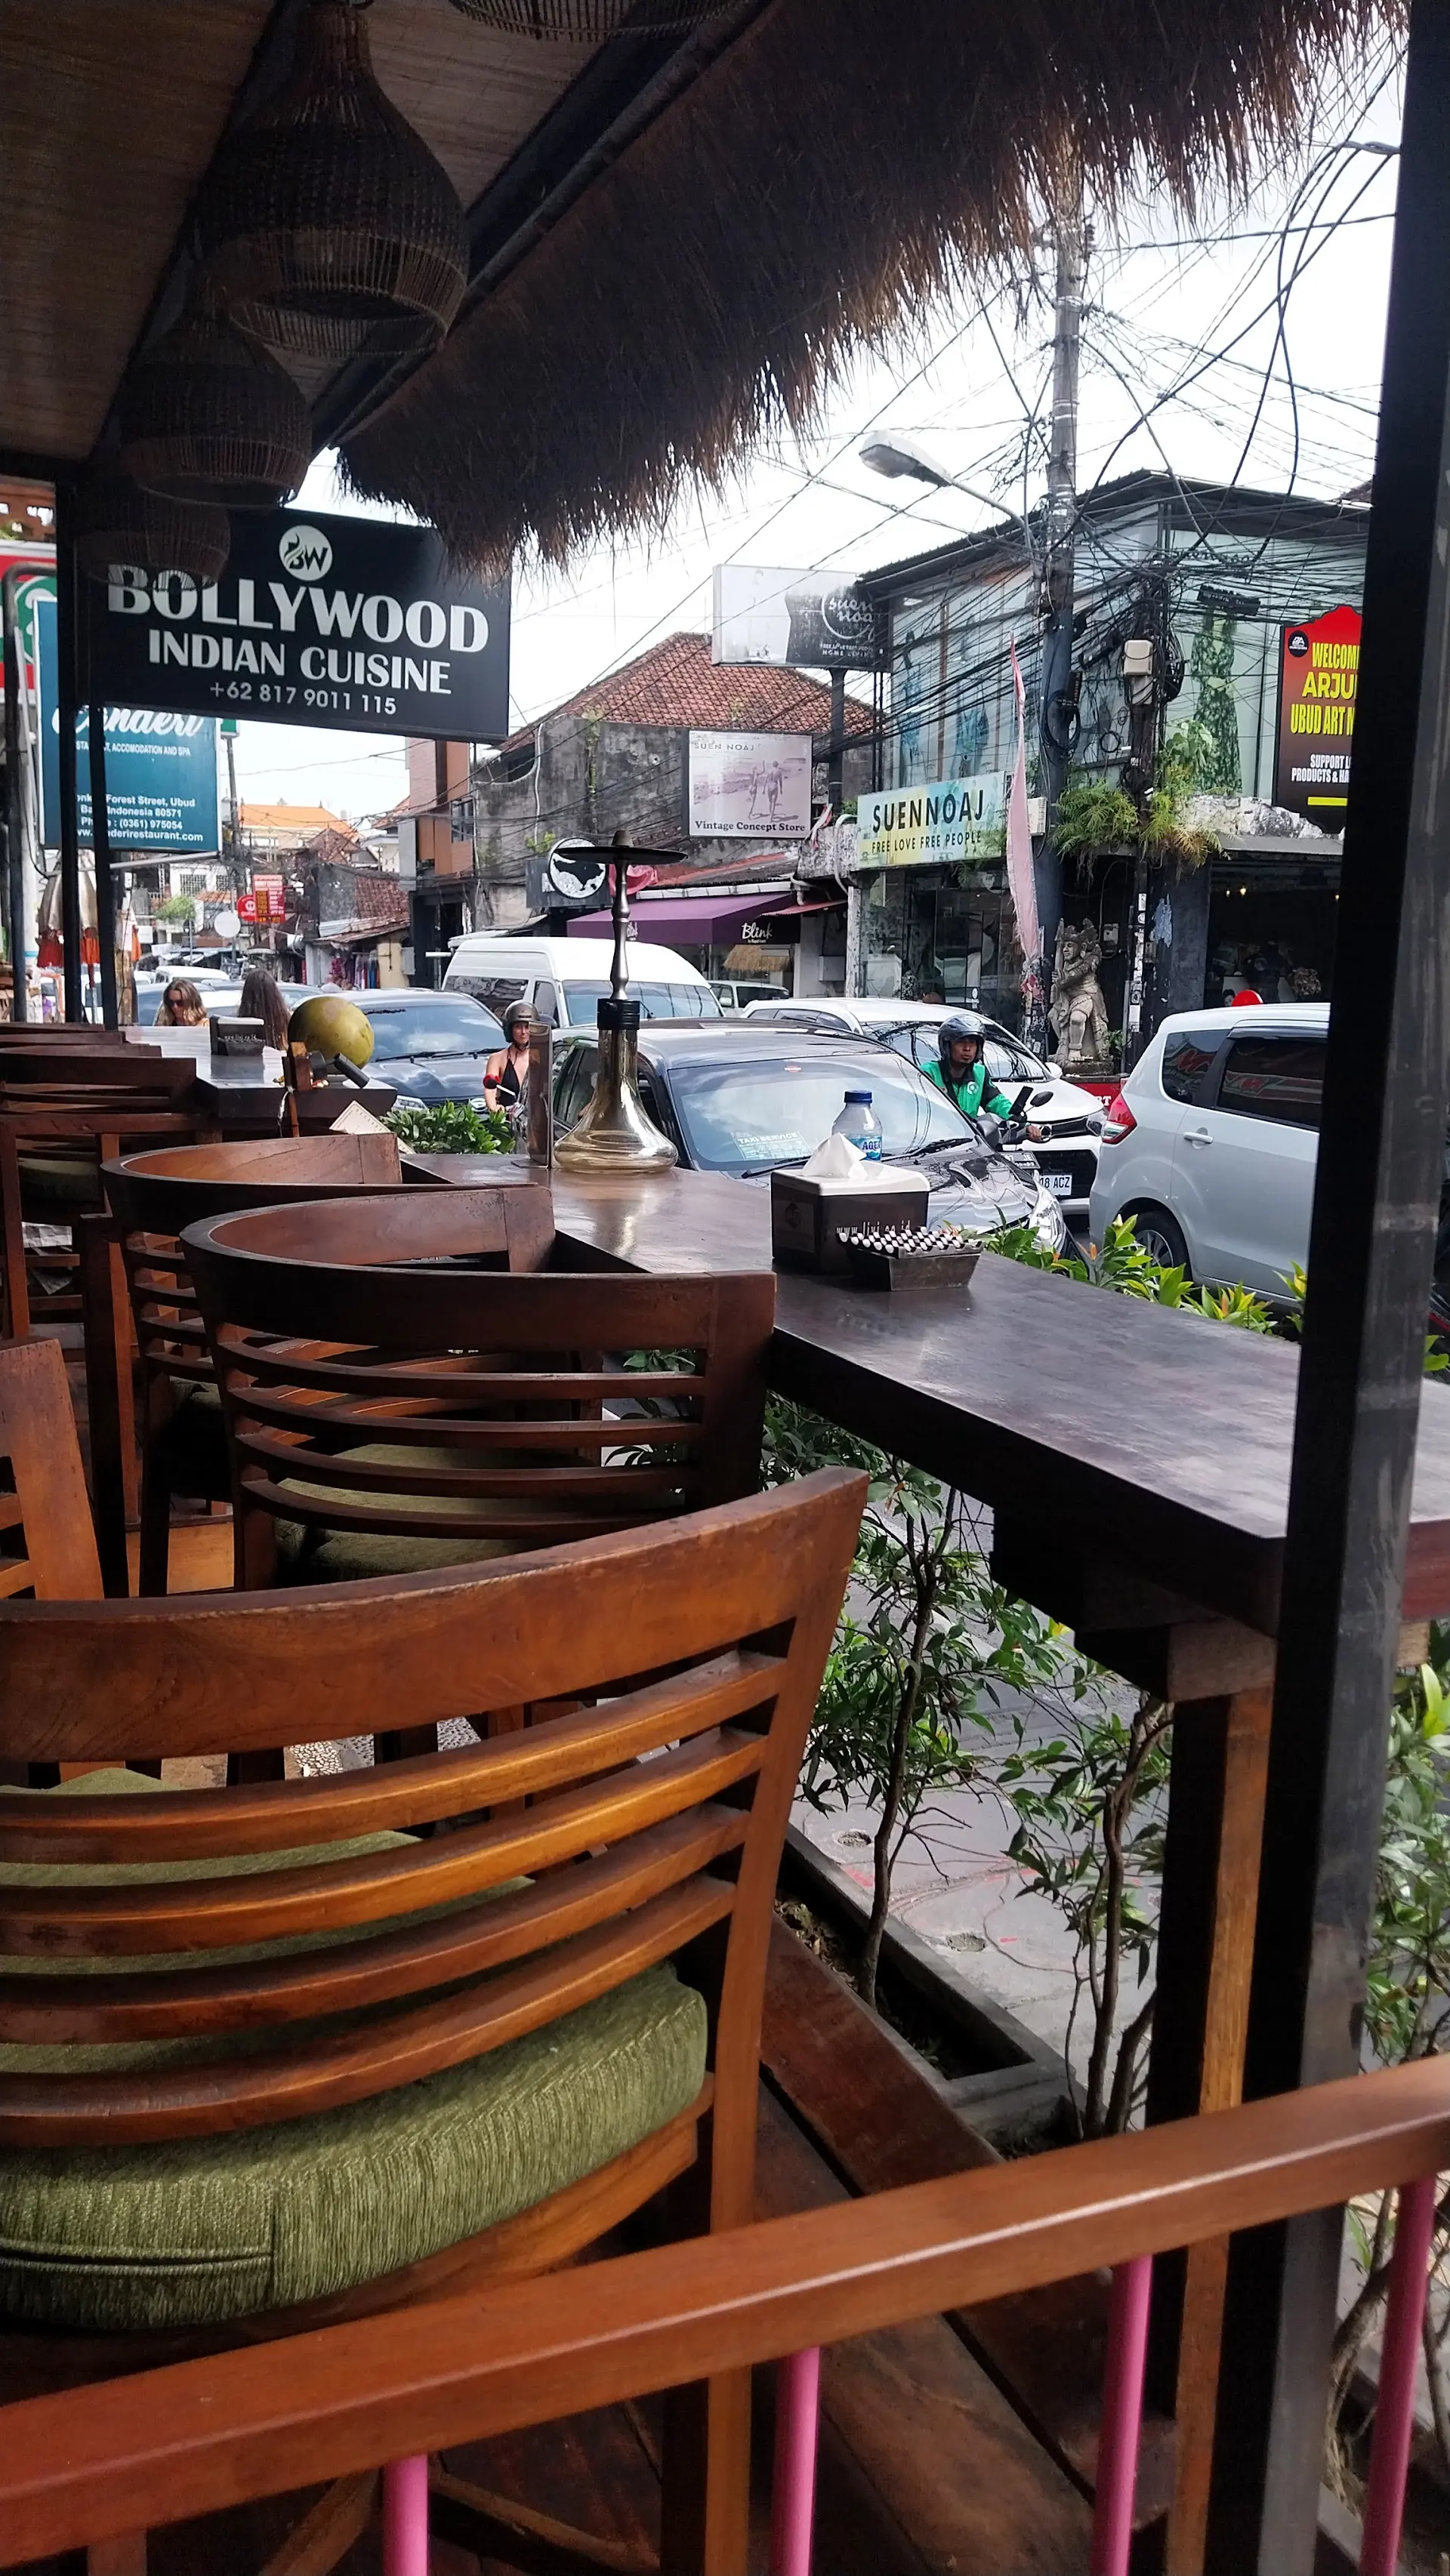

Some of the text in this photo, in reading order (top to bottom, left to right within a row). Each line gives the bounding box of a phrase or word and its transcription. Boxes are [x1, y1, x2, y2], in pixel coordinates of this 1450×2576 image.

[108, 564, 489, 652] BOLLYWOOD
[150, 629, 452, 694] INDIAN CUISINE
[1312, 642, 1359, 670] WELCOM
[1302, 671, 1358, 699] ARJU
[210, 681, 396, 715] +62 817 9011 115
[1290, 704, 1322, 734] UBUD
[1323, 705, 1345, 735] ART
[163, 746, 177, 756] AND
[178, 747, 191, 756] SPA
[1310, 753, 1345, 769] SUPPORT
[1291, 767, 1331, 782] PRODUCTS
[1331, 771, 1338, 783] &
[106, 794, 136, 805] Forest
[137, 796, 168, 807] Street,
[170, 797, 196, 807] Ubud
[107, 806, 153, 816] Indonesia
[155, 809, 181, 818] 80571
[872, 790, 983, 833] SUENNOAJ
[119, 818, 147, 830] (0361)
[150, 820, 183, 830] 975054
[695, 821, 806, 832] Vintage Concept Store
[872, 830, 981, 853] FREE LOVE FREE PEOPLE
[741, 922, 773, 939] Blink
[737, 1132, 798, 1145] TAXI SERVICE
[1053, 1176, 1070, 1188] ACZ
